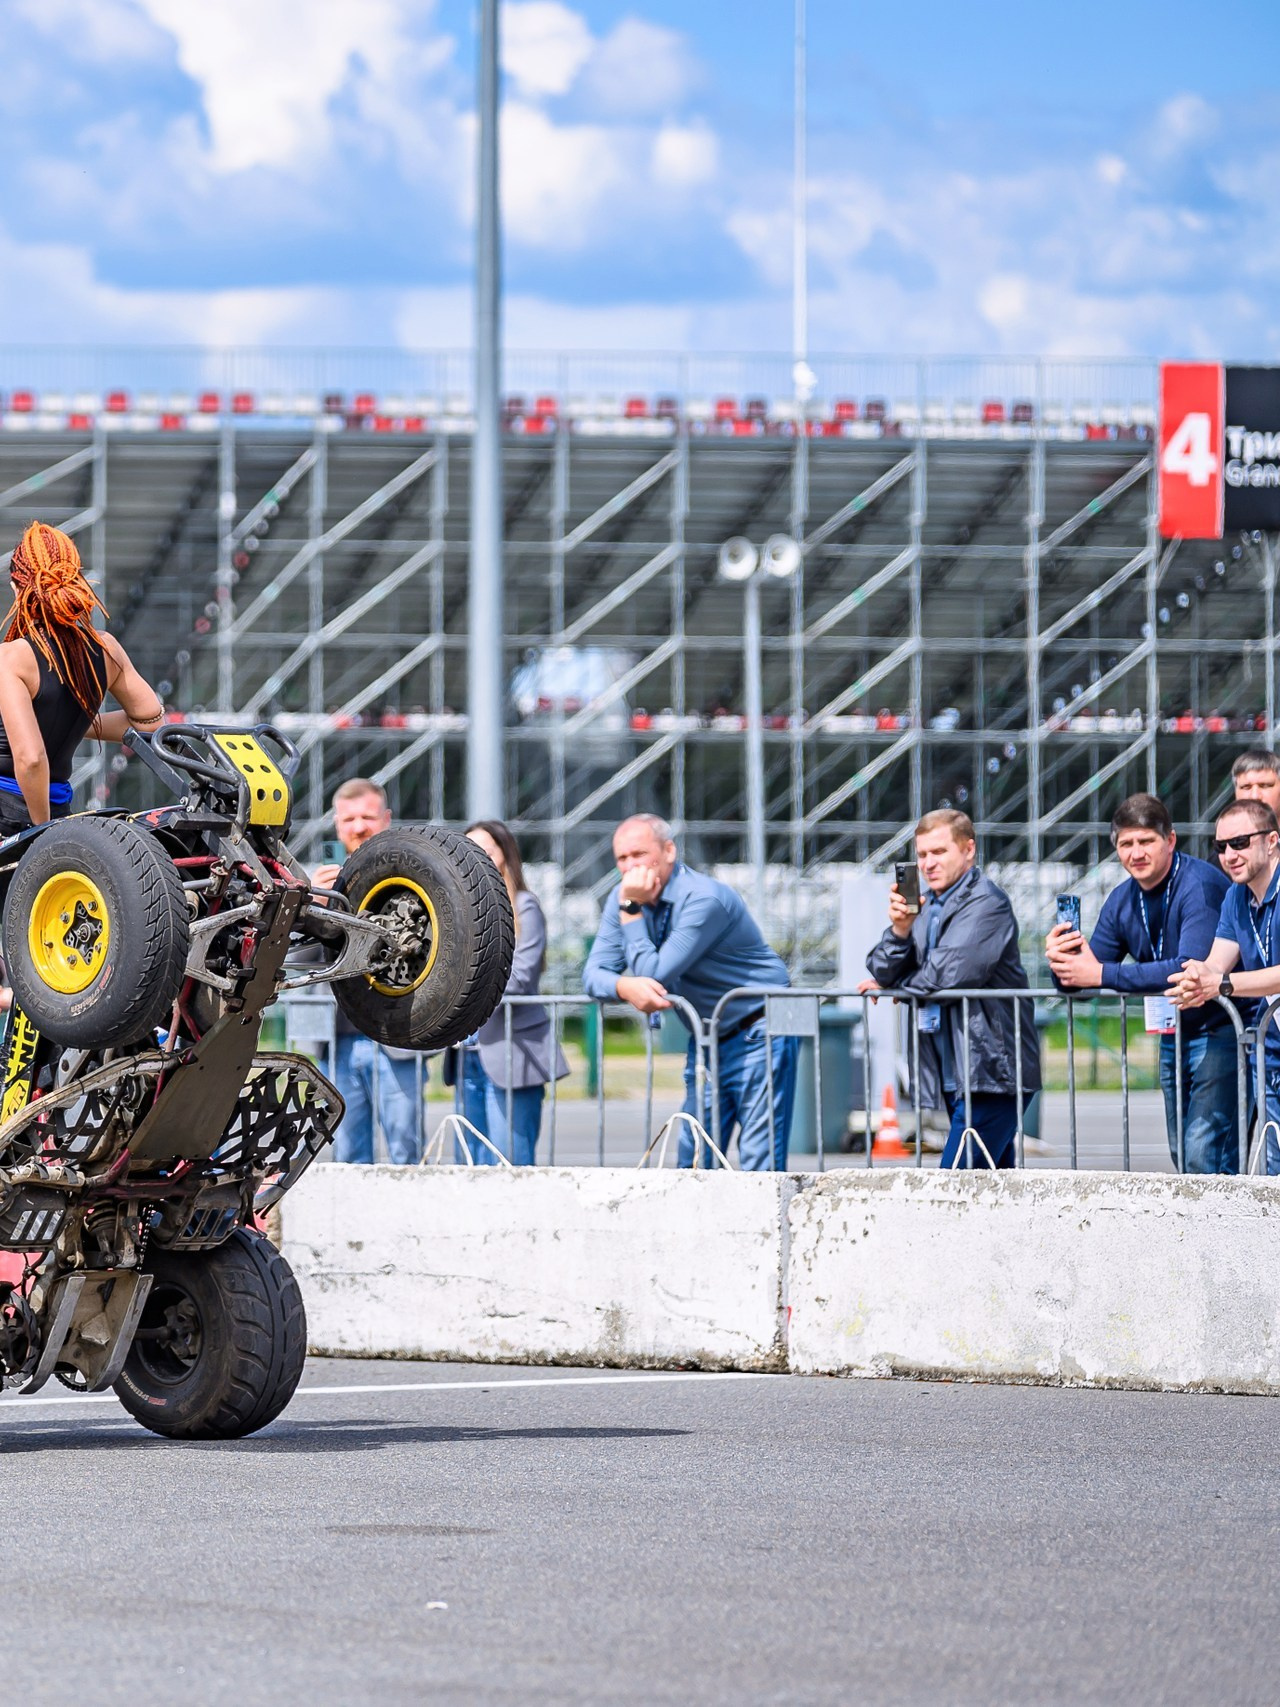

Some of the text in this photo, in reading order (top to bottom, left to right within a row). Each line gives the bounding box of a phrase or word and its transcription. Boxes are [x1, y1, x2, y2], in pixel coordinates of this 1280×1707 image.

[1163, 412, 1217, 487] 4
[1225, 459, 1280, 488] Gran
[375, 851, 434, 882] KENDA
